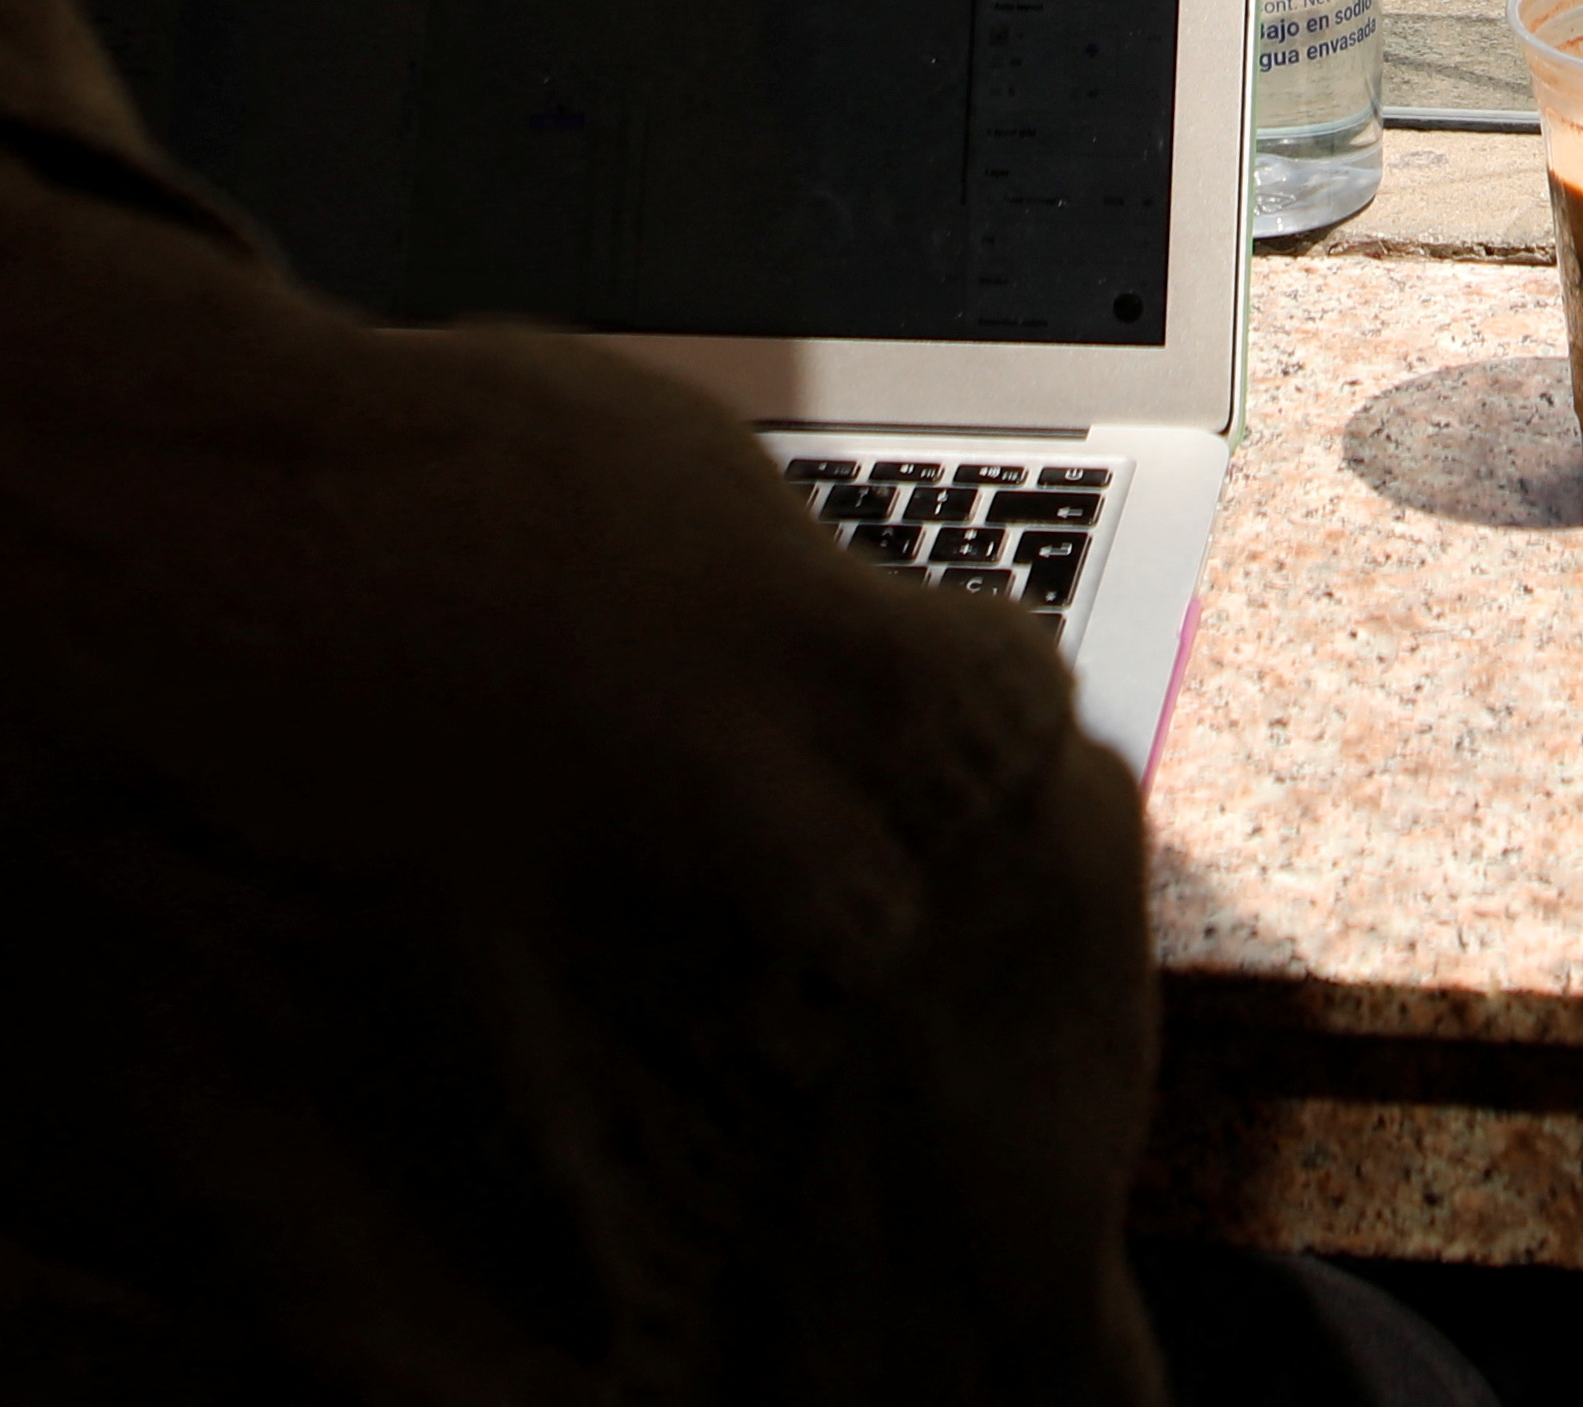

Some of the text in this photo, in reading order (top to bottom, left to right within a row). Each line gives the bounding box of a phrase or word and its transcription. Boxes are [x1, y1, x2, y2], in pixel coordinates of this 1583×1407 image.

[1306, 14, 1330, 33] en
[1259, 17, 1377, 73] gua envasada
